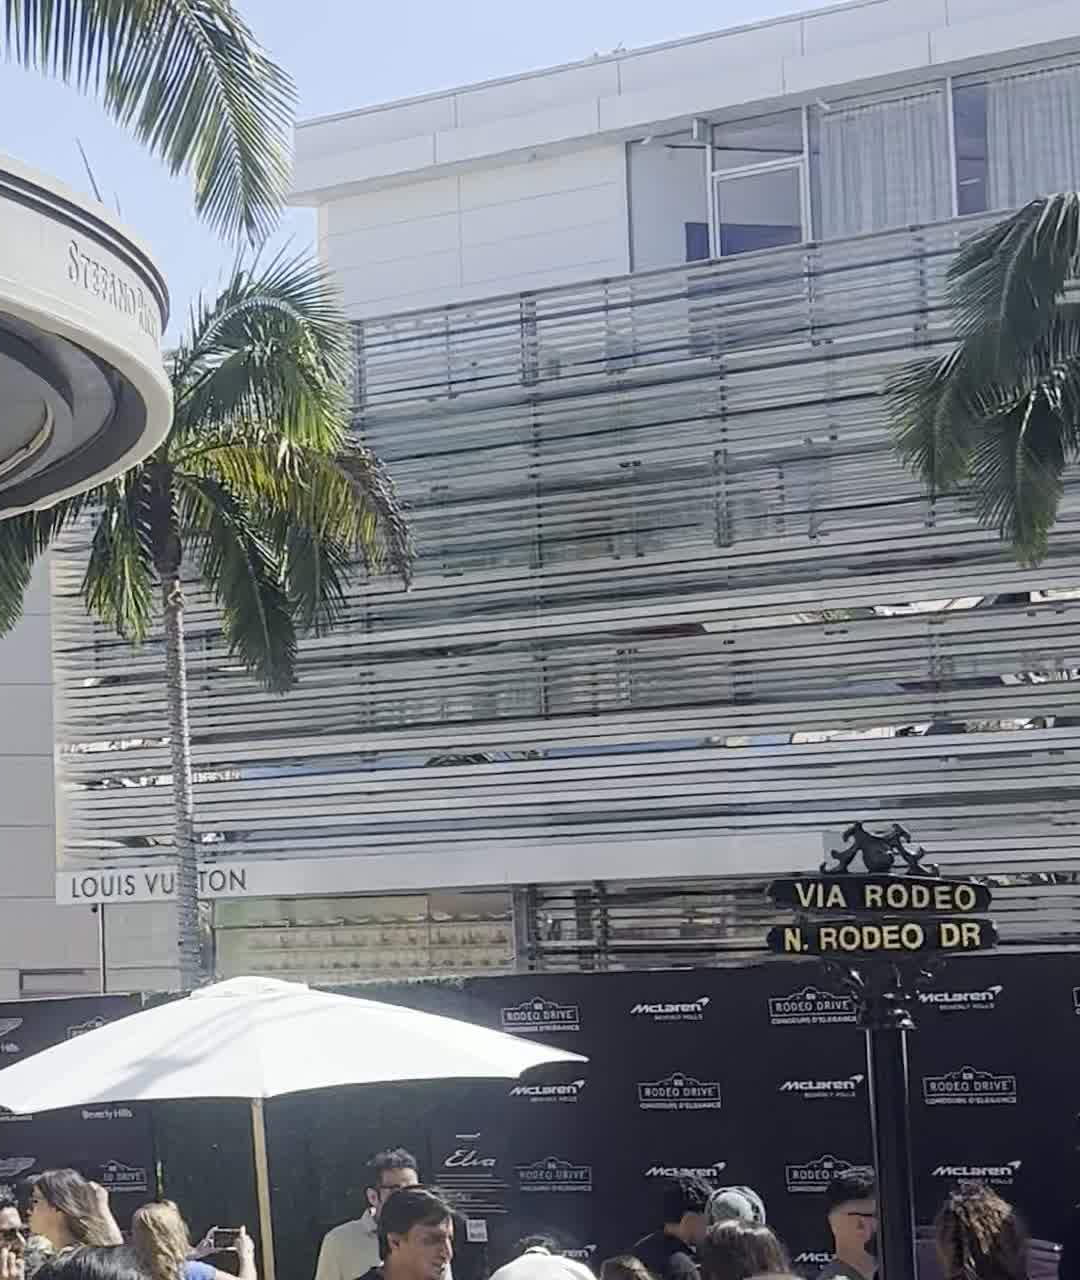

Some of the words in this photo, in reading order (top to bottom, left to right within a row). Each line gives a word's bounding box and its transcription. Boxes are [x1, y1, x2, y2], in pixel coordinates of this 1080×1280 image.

[72, 874, 135, 898] LOUIS
[145, 868, 247, 895] VUTON
[795, 882, 847, 908] VIA
[864, 883, 977, 911] RODEO
[784, 927, 809, 952] N.
[820, 923, 925, 951] RODEO
[940, 922, 982, 948] DR
[775, 1001, 813, 1012] RODEO
[816, 1000, 849, 1011] DRIVE
[506, 1011, 540, 1021] RODEO
[543, 1010, 573, 1020] DRIVE
[644, 1088, 680, 1097] RODEO
[683, 1087, 714, 1097] DRIVE
[930, 1081, 969, 1092] RODEO
[973, 1080, 1009, 1091] DRIVE
[444, 1149, 497, 1167] Elva
[792, 1169, 830, 1180] RODEO
